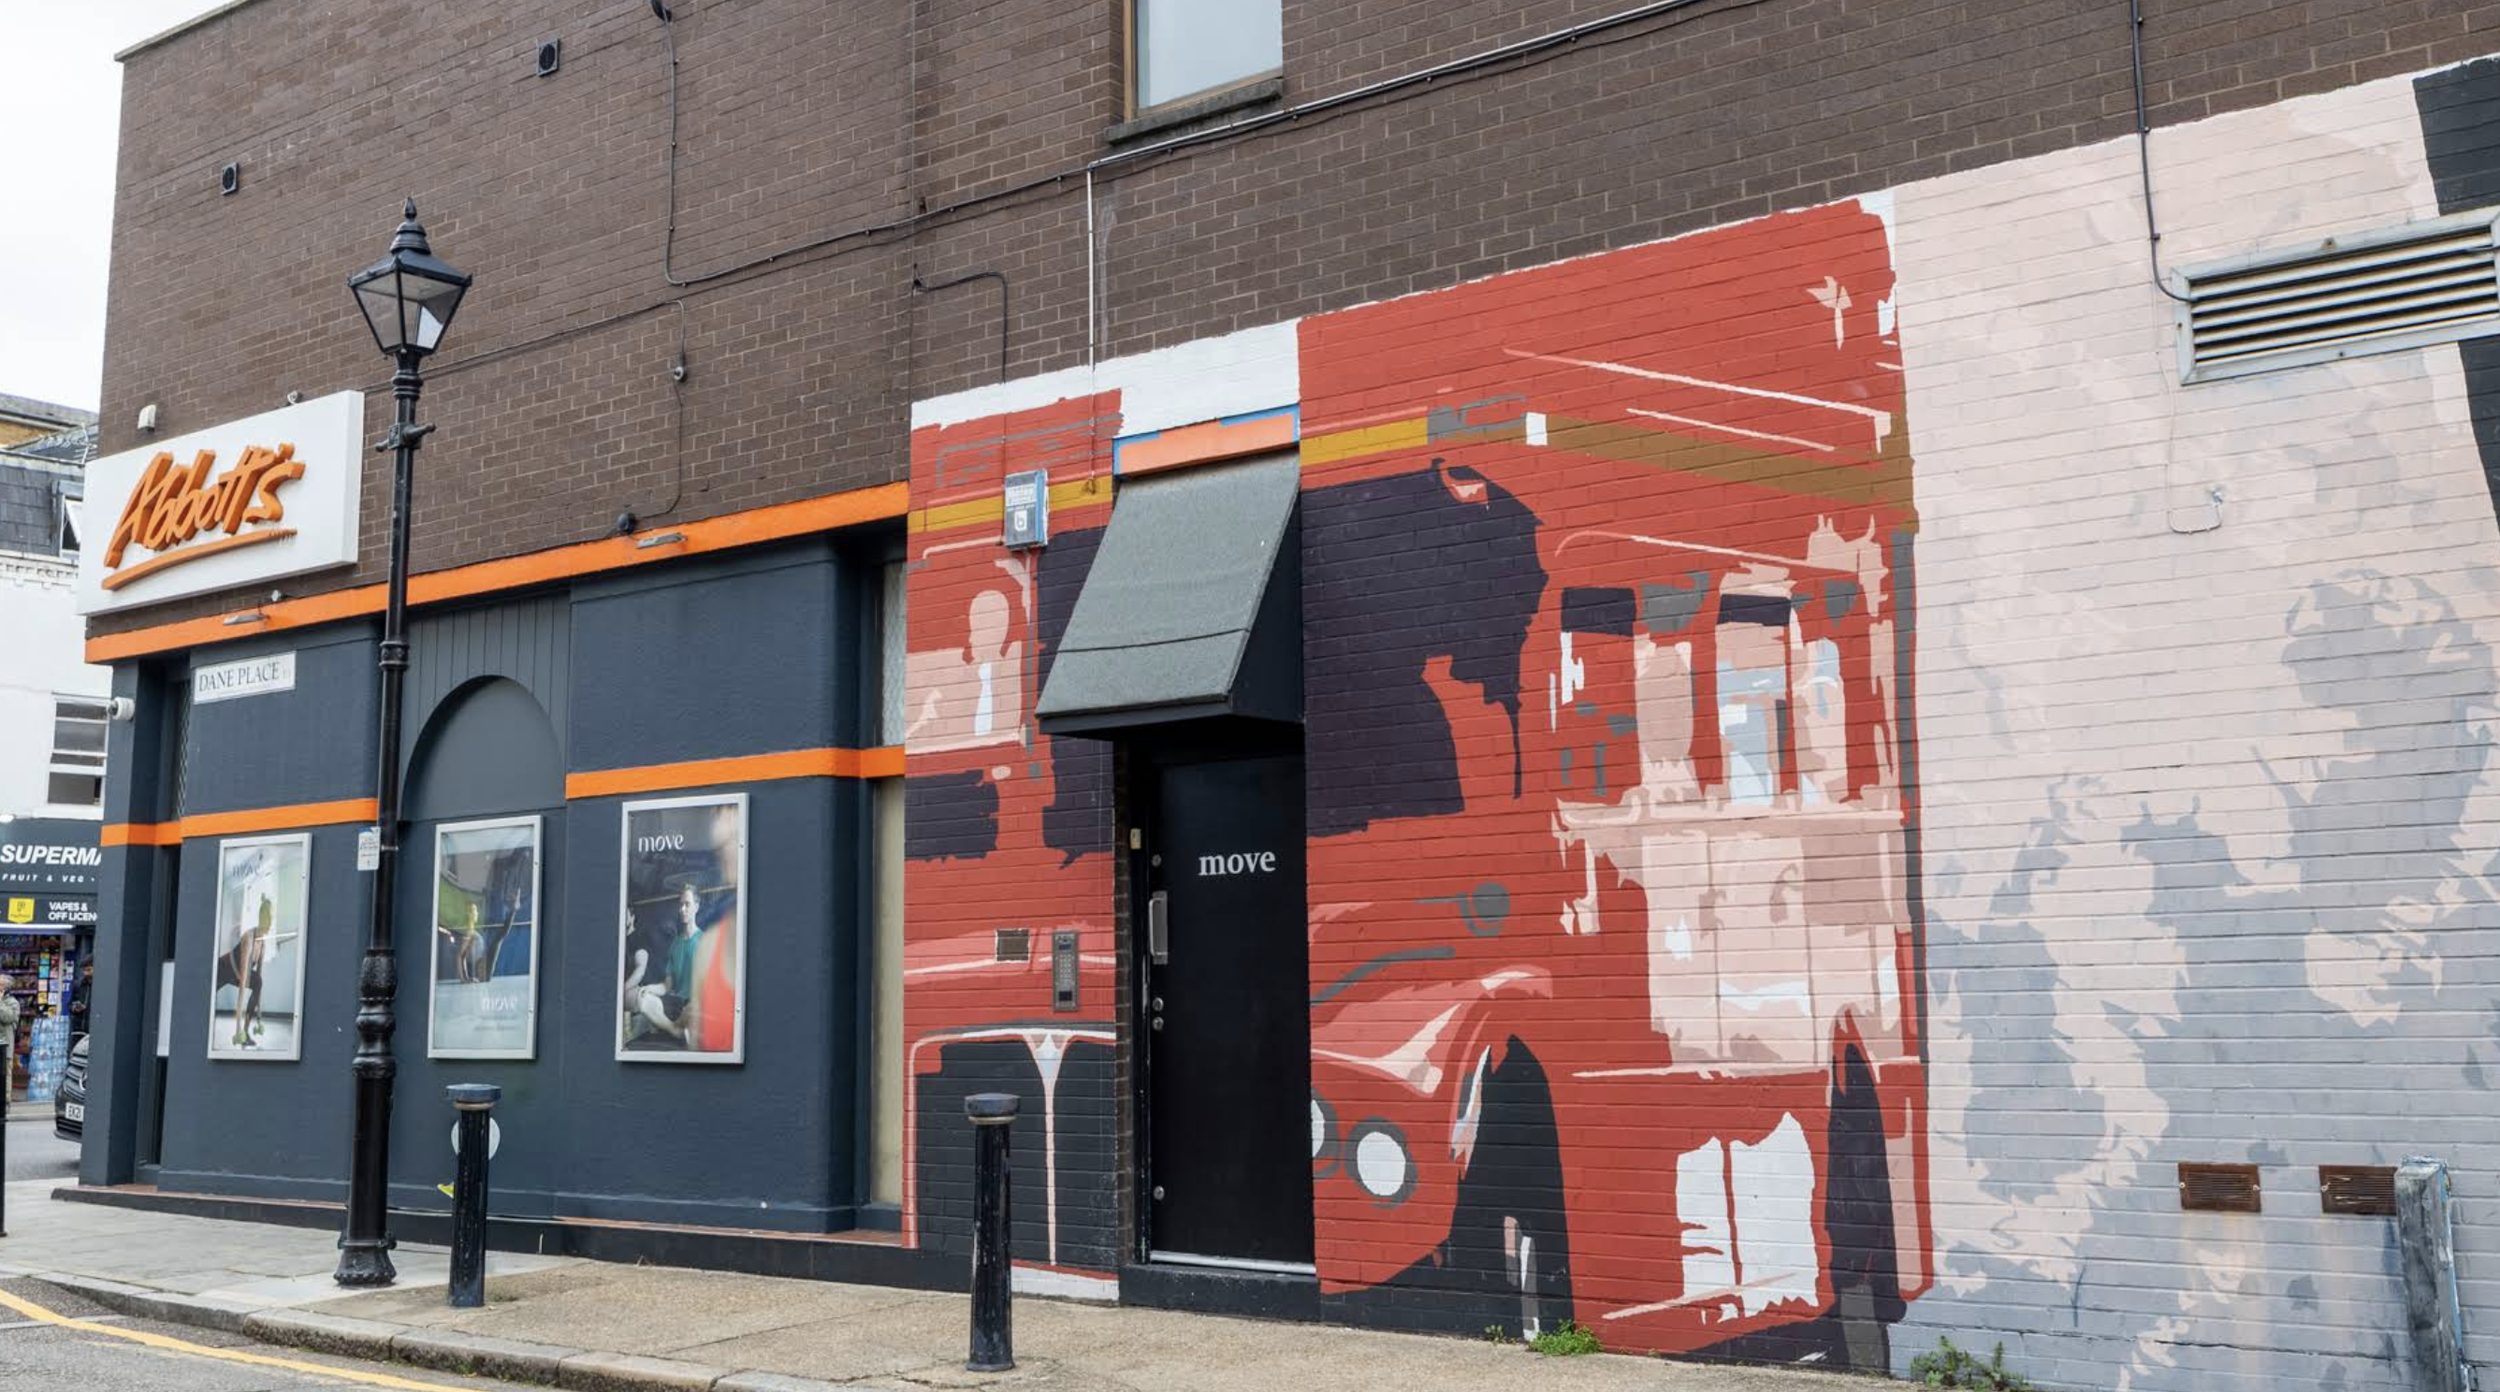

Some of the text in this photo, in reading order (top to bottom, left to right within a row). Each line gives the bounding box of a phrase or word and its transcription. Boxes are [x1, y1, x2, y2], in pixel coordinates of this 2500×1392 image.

[199, 668, 233, 691] DANE
[238, 661, 279, 685] PLACE
[638, 834, 684, 852] move
[1199, 851, 1276, 876] move
[2, 873, 38, 882] FRUIT
[49, 901, 80, 911] VAPES
[48, 911, 67, 921] OFF
[481, 995, 519, 1012] move
